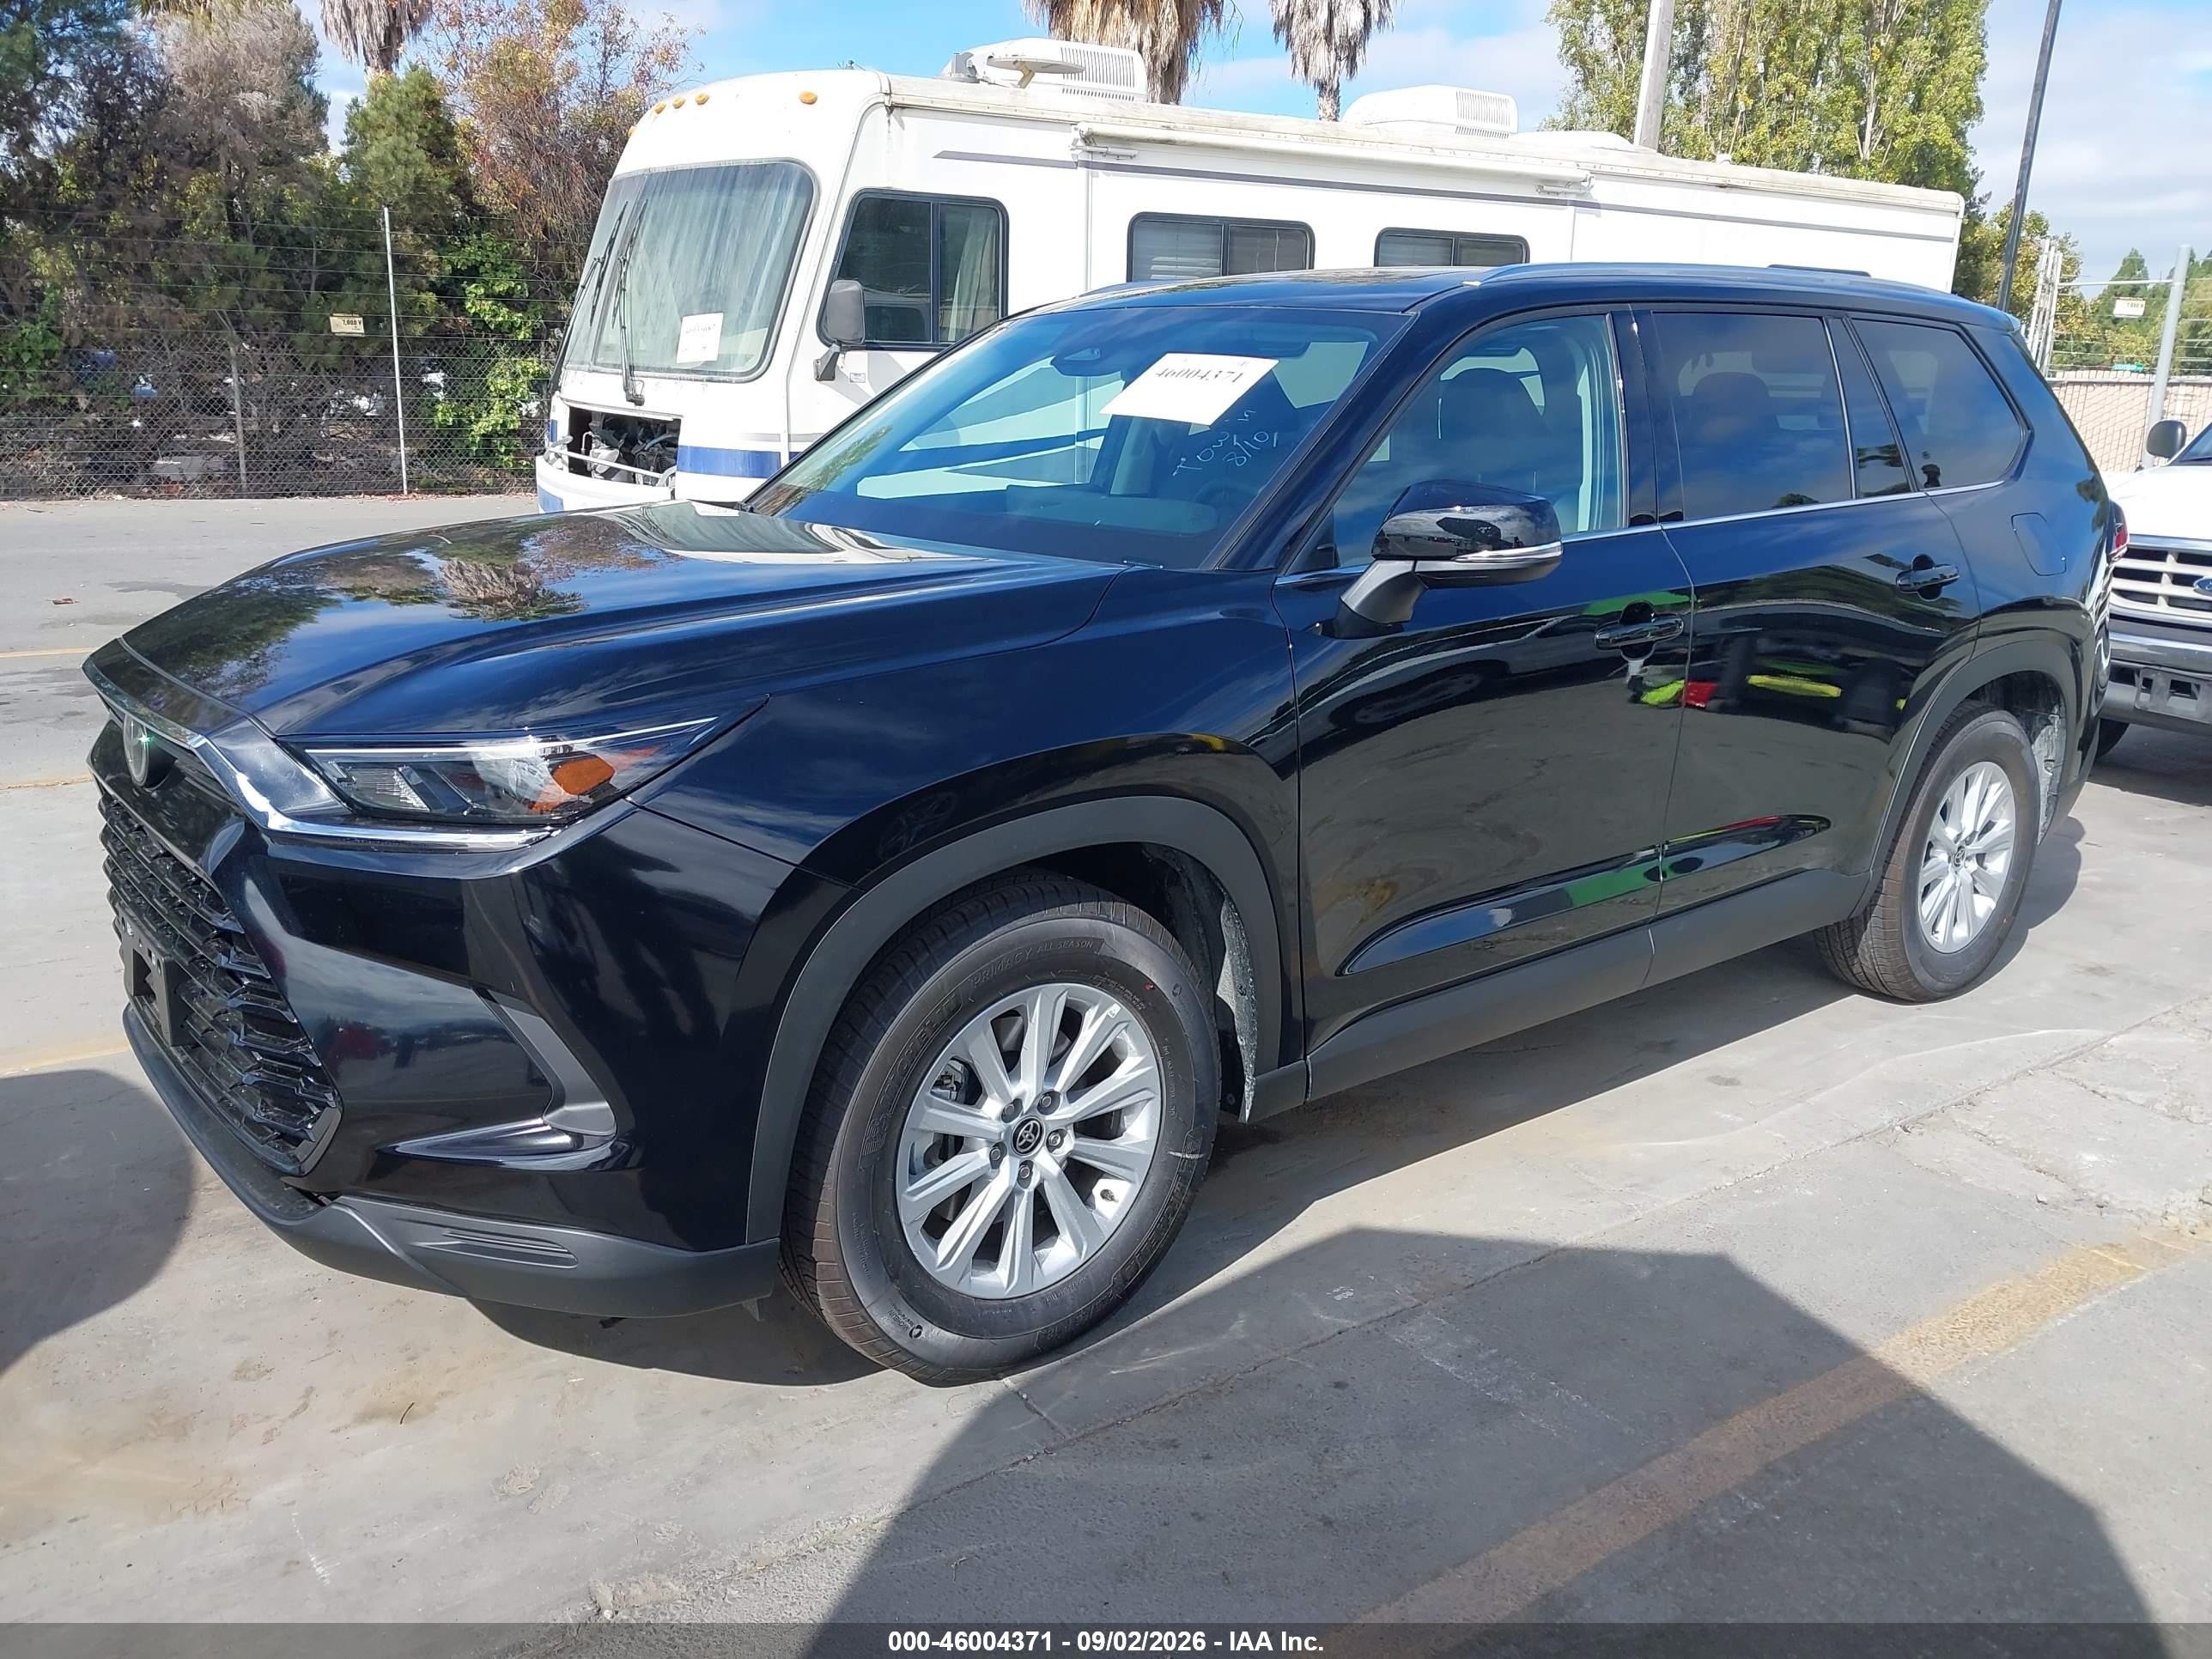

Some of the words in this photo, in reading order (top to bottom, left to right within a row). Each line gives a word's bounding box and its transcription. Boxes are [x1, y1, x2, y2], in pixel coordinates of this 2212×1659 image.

[972, 947, 1032, 988] PRIMACY
[1037, 942, 1053, 954] ALL
[1057, 939, 1094, 950] SEASON
